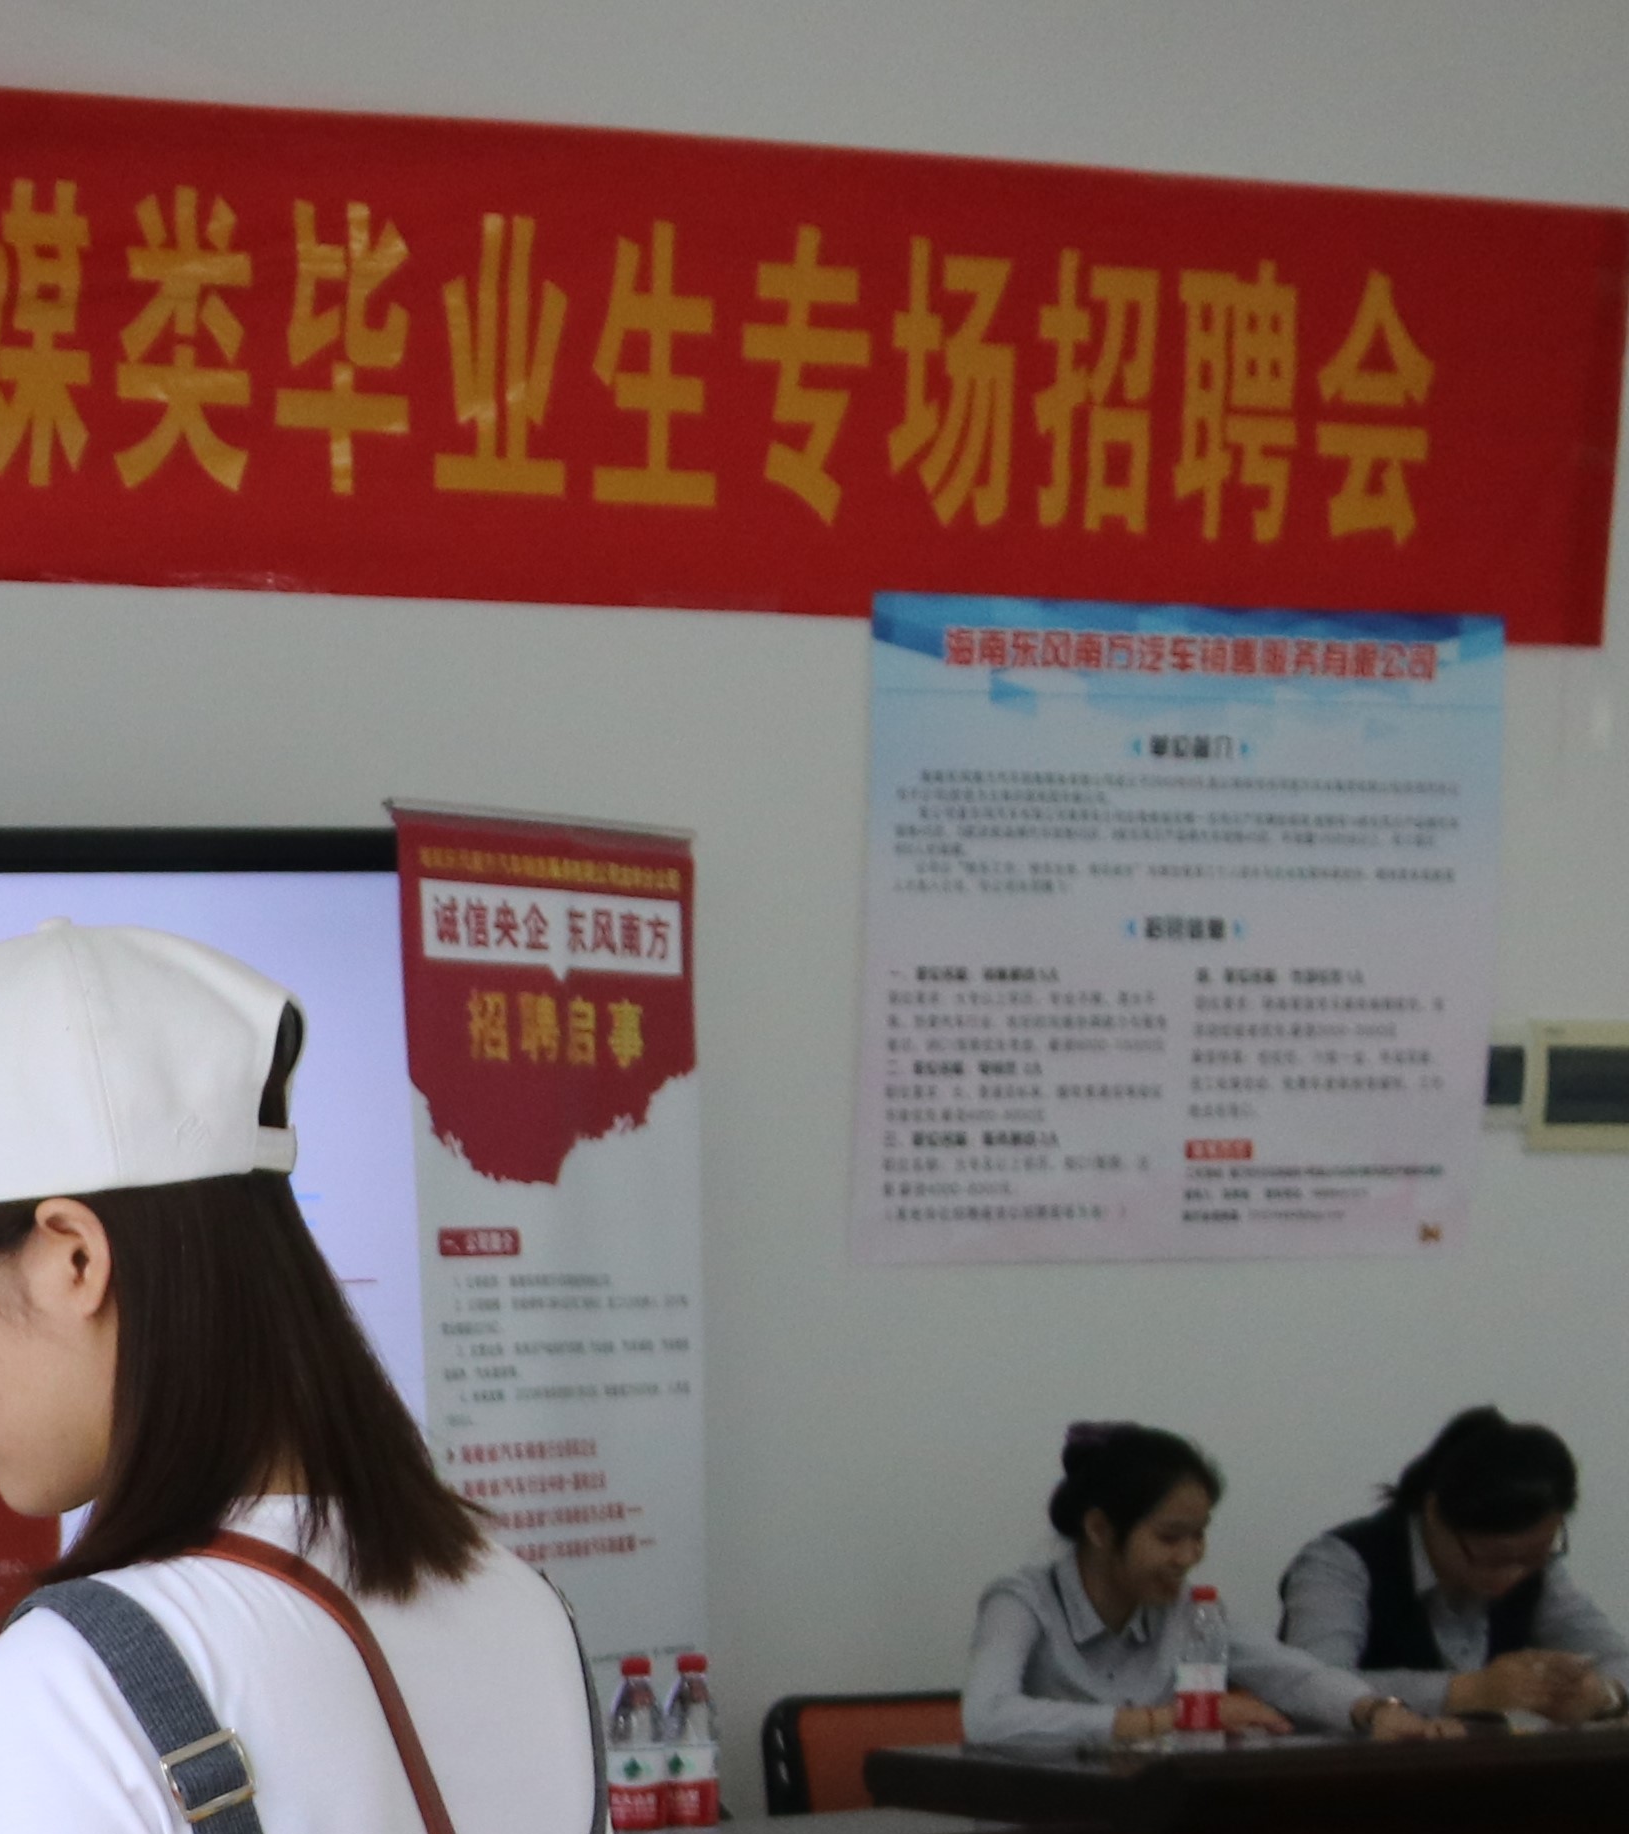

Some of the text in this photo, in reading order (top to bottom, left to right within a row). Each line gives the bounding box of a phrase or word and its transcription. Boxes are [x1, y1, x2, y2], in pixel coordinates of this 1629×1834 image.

[433, 898, 671, 960] 诚信央企 东风南方
